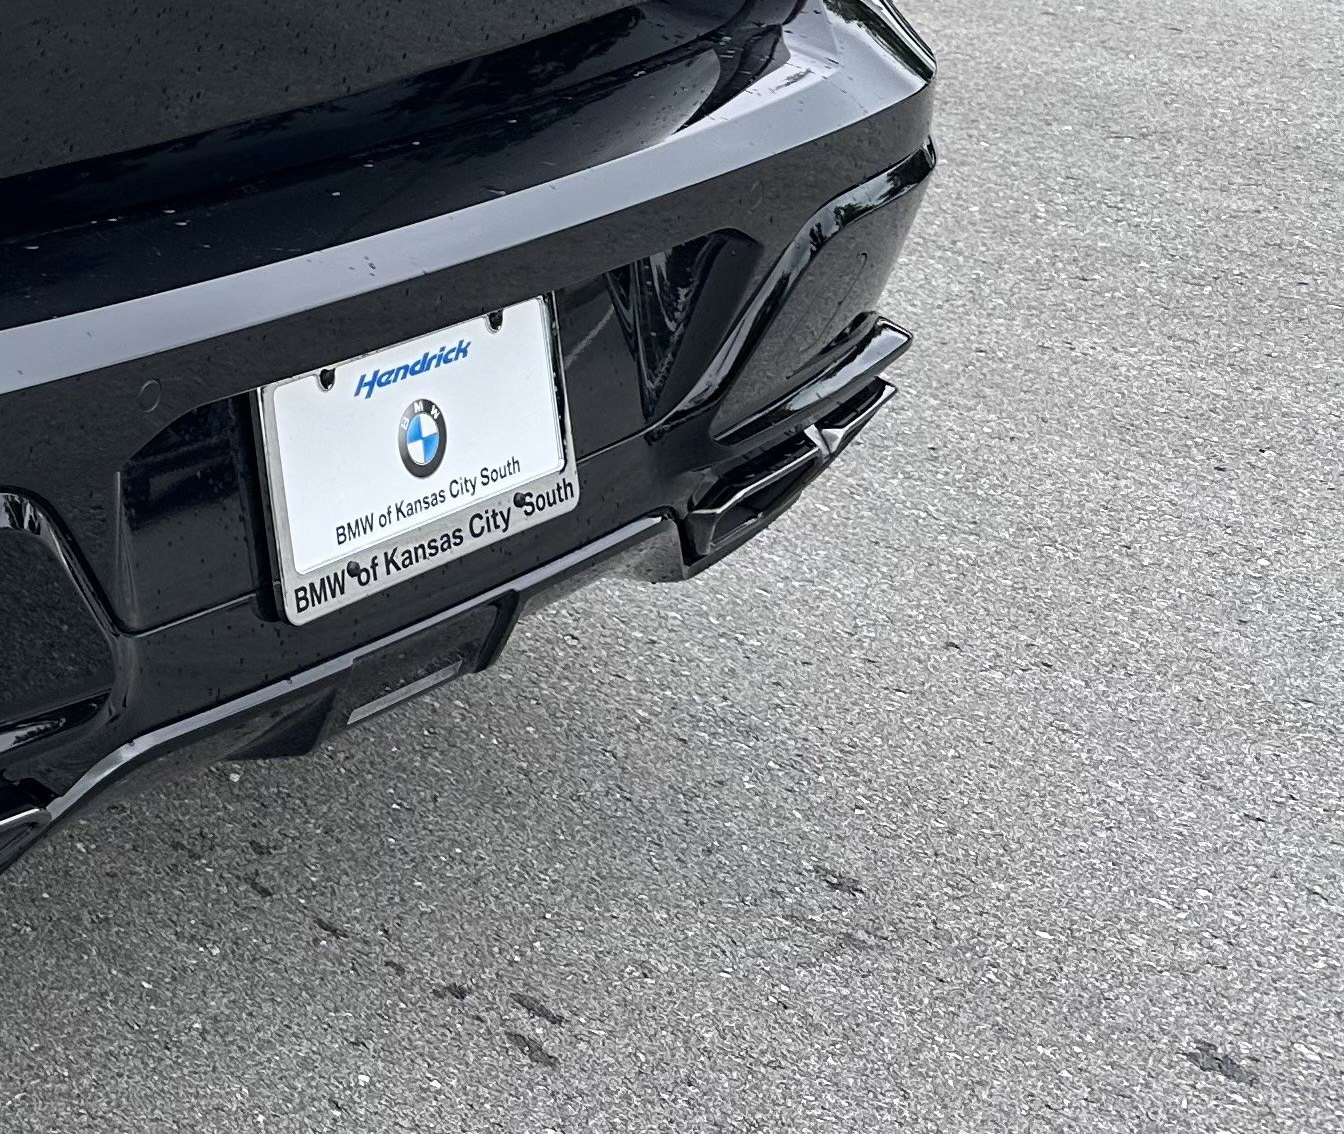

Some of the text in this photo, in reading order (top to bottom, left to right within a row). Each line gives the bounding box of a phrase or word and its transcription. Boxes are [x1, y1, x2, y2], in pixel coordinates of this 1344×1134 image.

[354, 339, 471, 399] Hendrick
[401, 400, 440, 431] BMW
[335, 456, 521, 545] BMW of Kansas City South
[294, 478, 575, 614] BMW of Kansas City South
